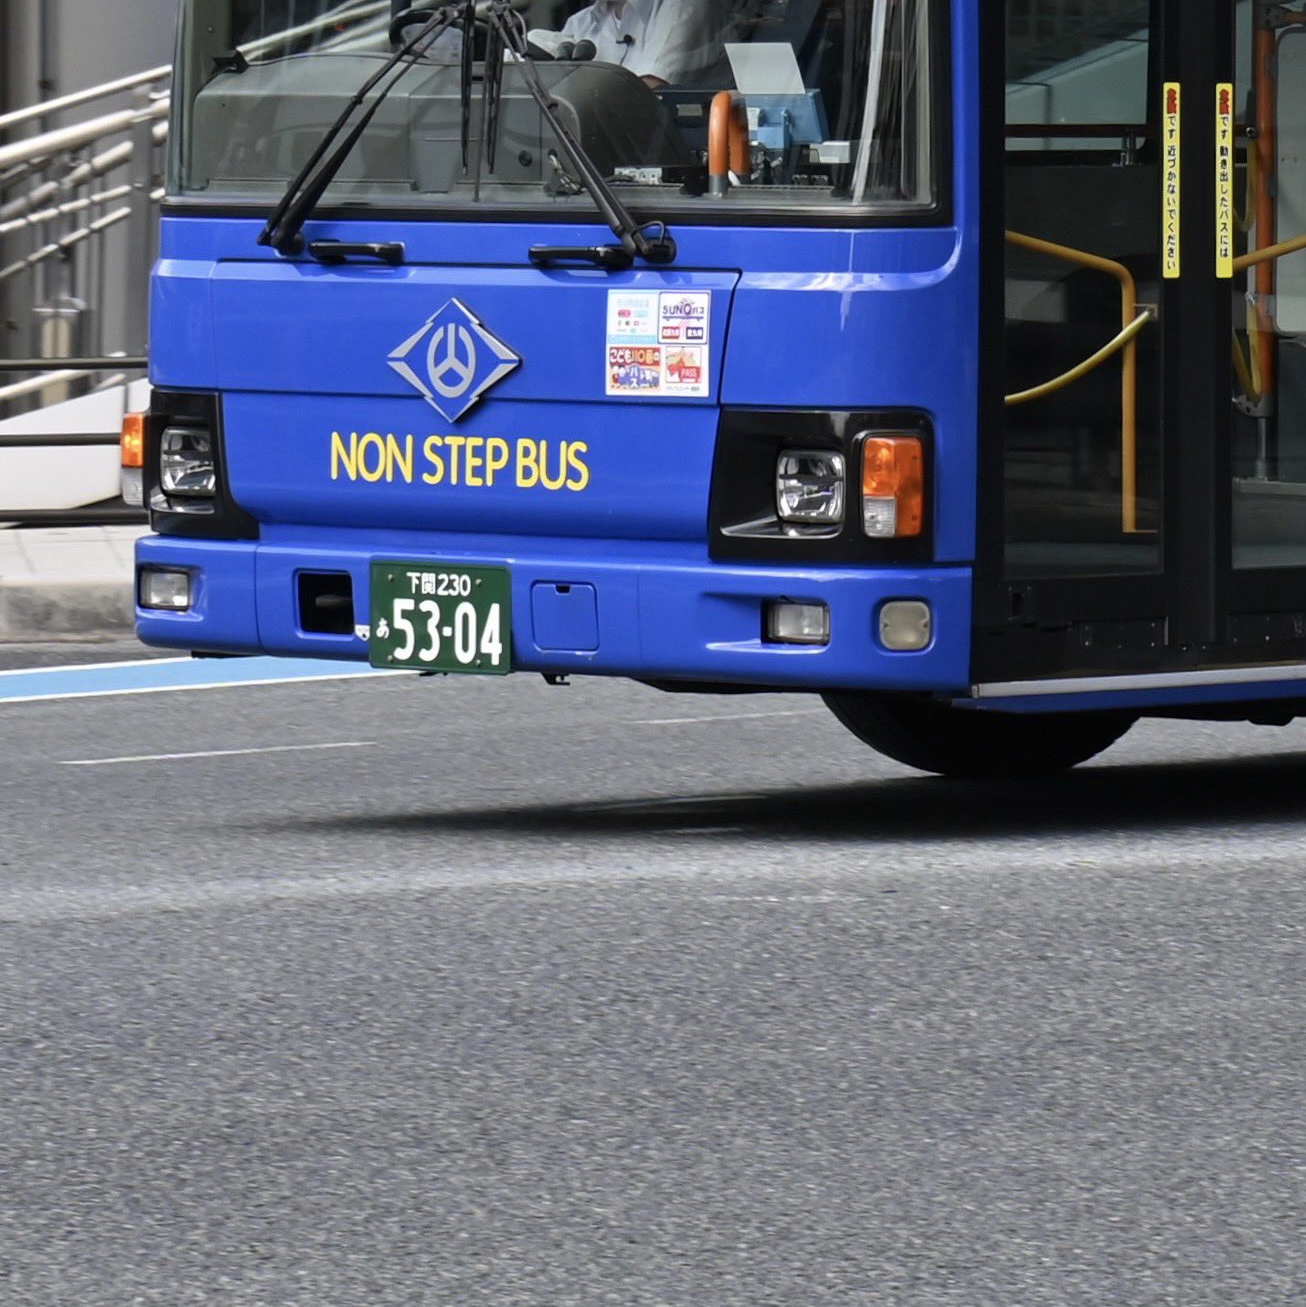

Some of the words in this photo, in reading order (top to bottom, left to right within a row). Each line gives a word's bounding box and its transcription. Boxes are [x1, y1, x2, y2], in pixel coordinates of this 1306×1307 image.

[331, 431, 413, 484] NON
[422, 435, 509, 486] STEP
[516, 438, 589, 491] BUS
[376, 617, 390, 639] あ
[393, 598, 503, 666] 53-04
